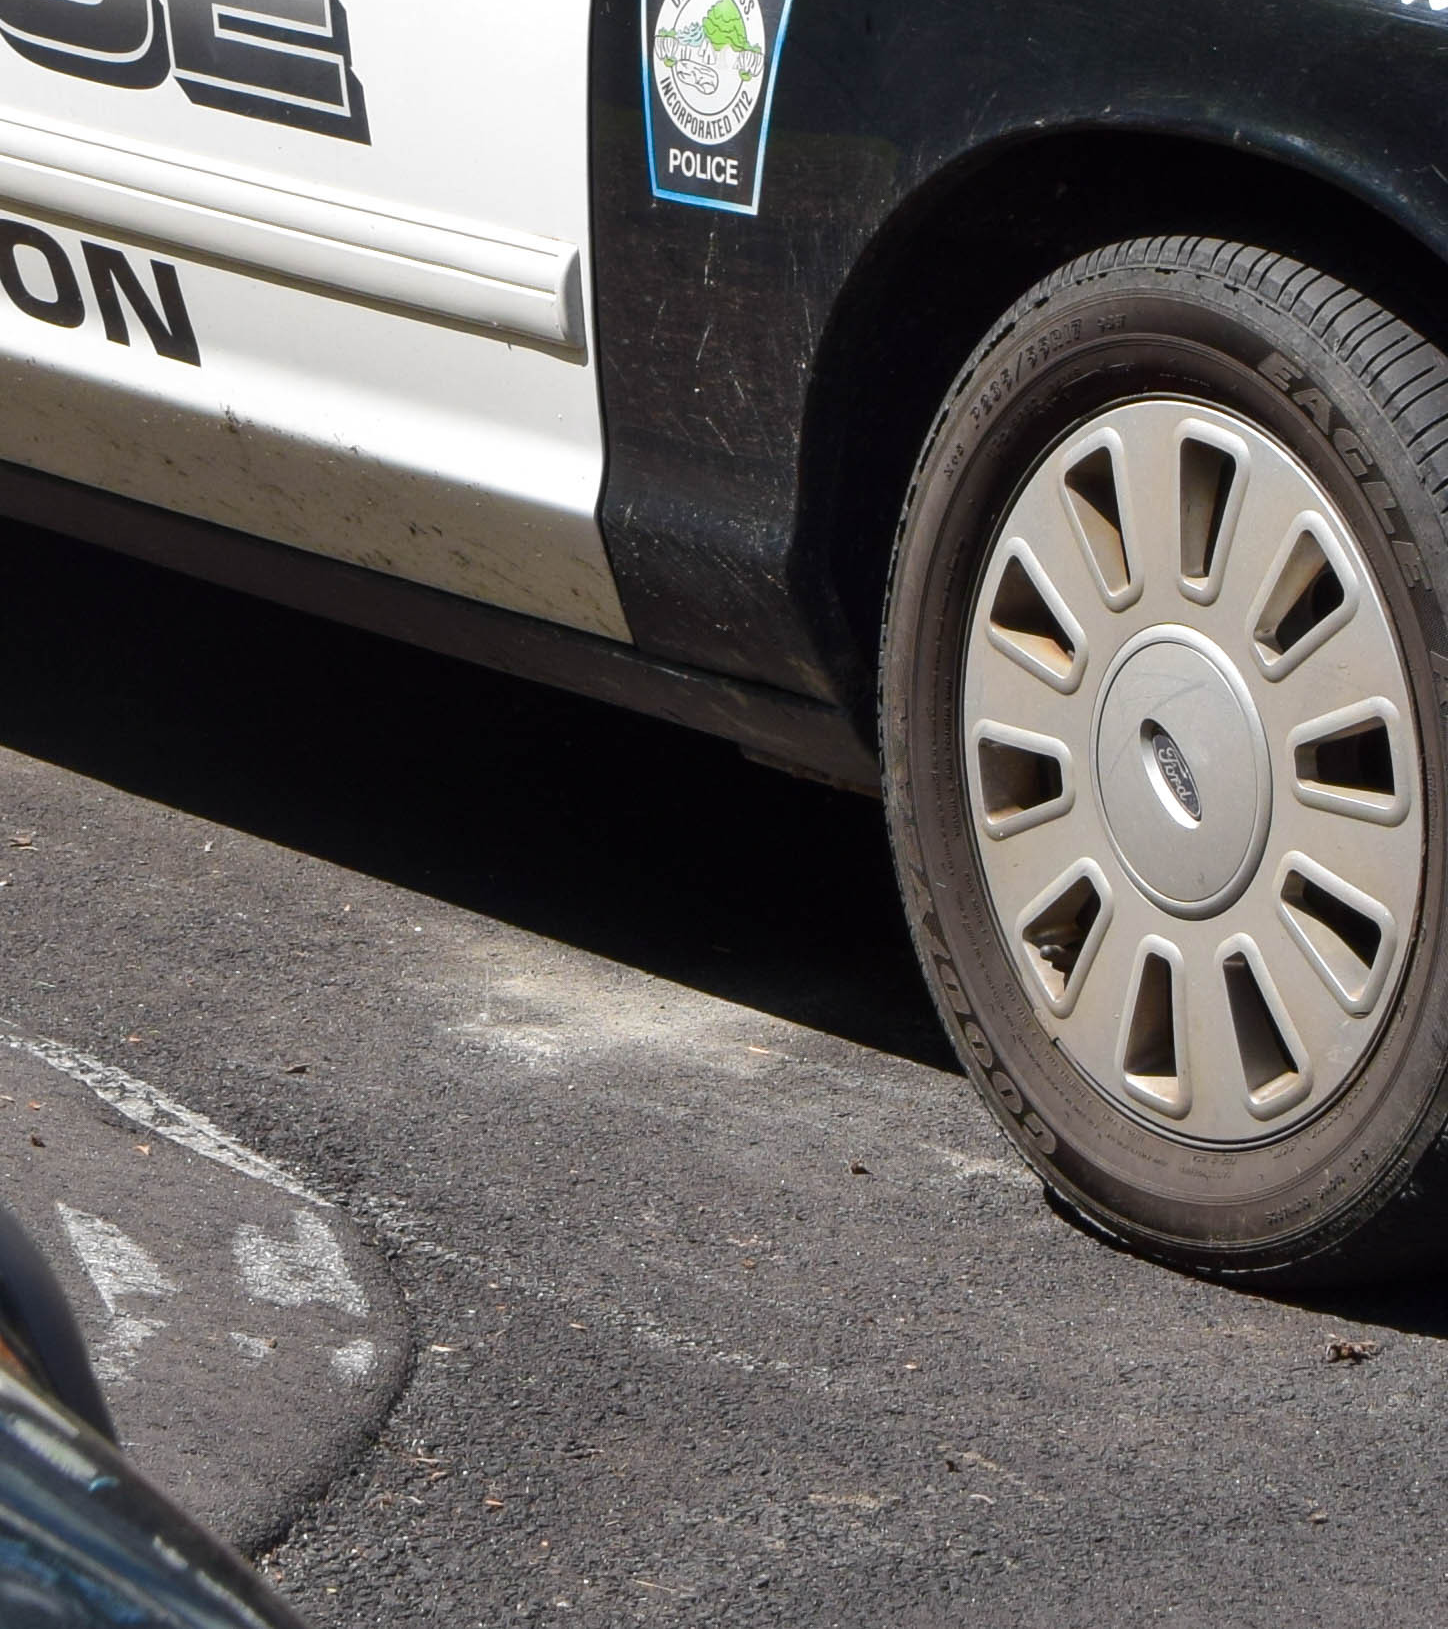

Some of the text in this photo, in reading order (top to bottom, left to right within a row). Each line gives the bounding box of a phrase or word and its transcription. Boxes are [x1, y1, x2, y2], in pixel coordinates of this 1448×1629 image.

[659, 75, 754, 140] INCORPORATED 1712
[669, 147, 739, 185] POLICE
[1257, 350, 1433, 592] EAGLE
[1157, 746, 1192, 802] Ford
